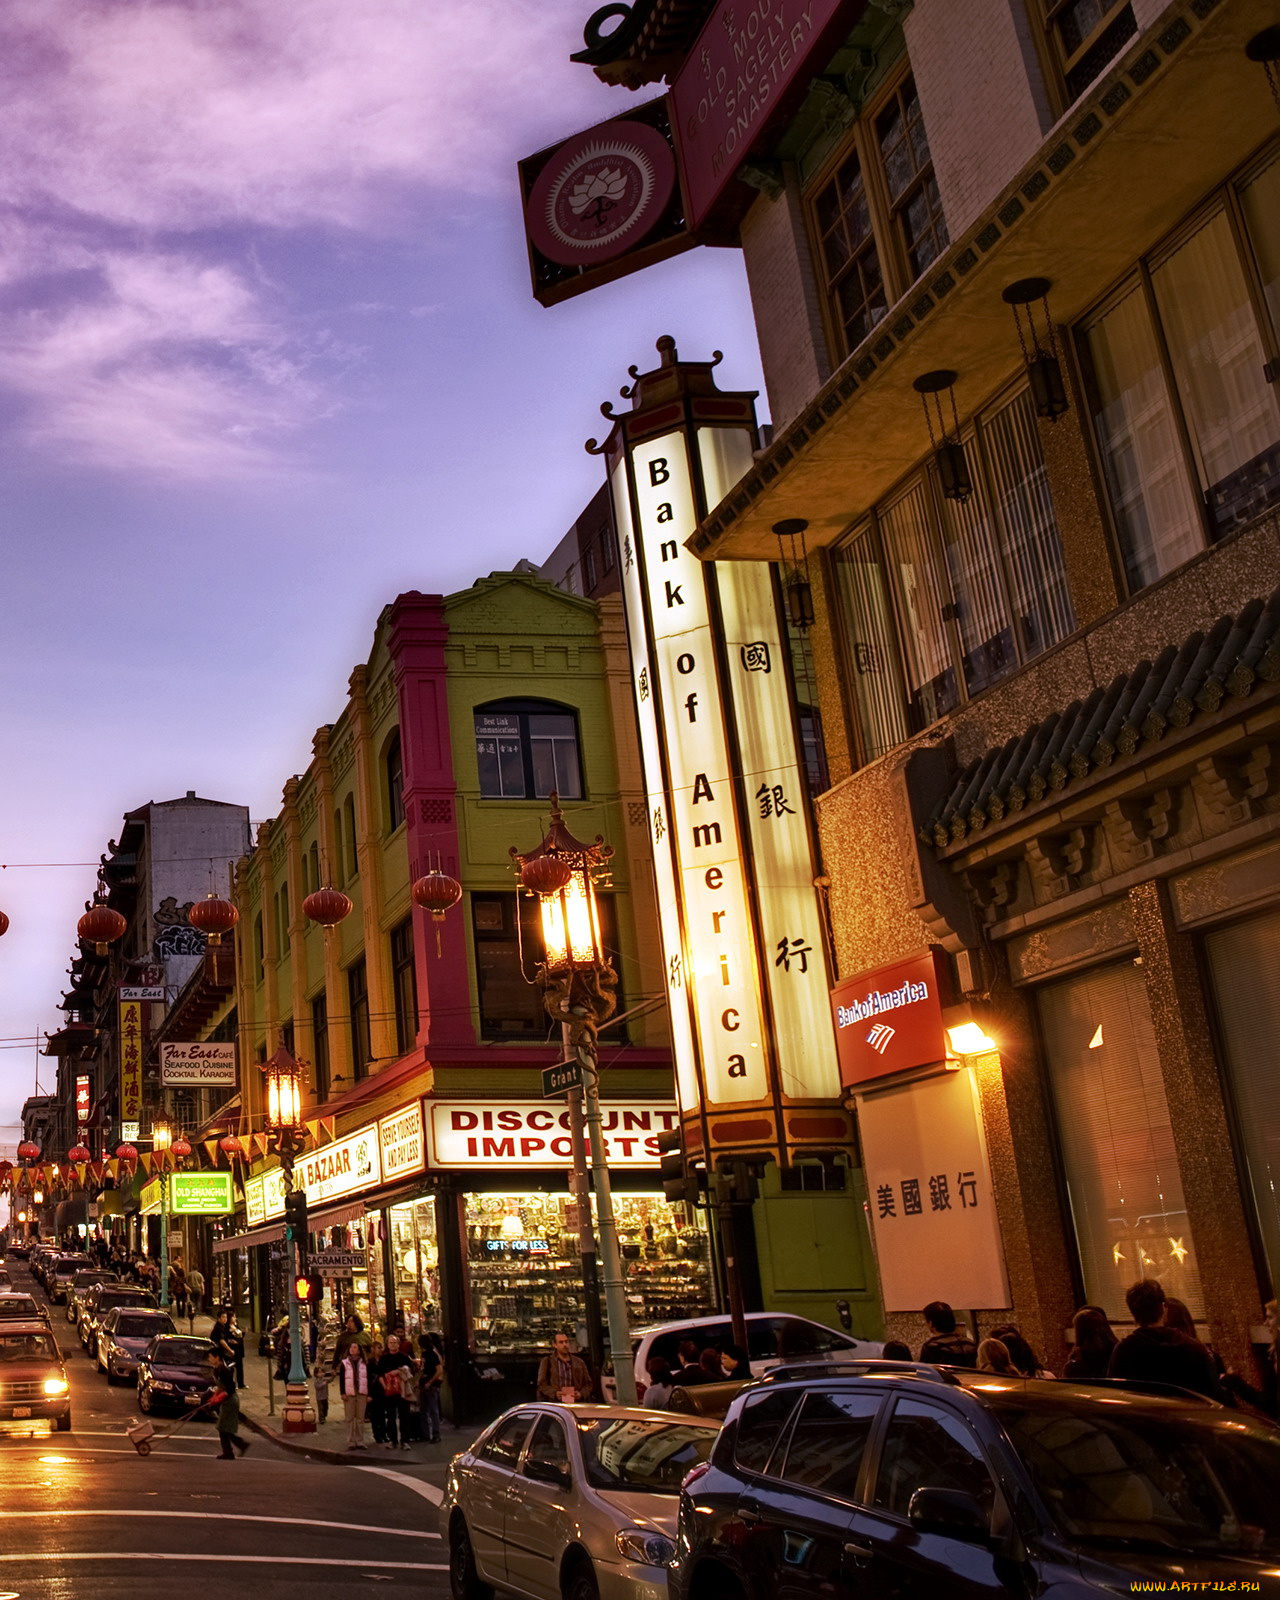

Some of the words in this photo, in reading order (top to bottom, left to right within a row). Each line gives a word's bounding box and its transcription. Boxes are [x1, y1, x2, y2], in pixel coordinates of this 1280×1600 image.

[725, 2, 784, 117] SAGELY
[712, 2, 812, 177] MONASTERY
[688, 67, 726, 141] GOLD
[483, 717, 496, 726] Best
[496, 717, 509, 726] Link
[476, 726, 518, 734] Communications
[649, 457, 685, 608] Bank
[677, 652, 699, 723] of
[692, 773, 747, 1079] America
[122, 988, 138, 998] Far
[141, 988, 162, 998] East
[163, 1044, 187, 1060] Far
[188, 1044, 220, 1060] East
[164, 1060, 200, 1069] SEAFOOD
[202, 1060, 234, 1069] CUISINE
[163, 1069, 198, 1079] COCKTAIL
[199, 1069, 234, 1079] KARAOKE
[550, 1066, 577, 1089] Grant
[450, 1110, 679, 1131] DISCOUNT
[307, 1148, 352, 1186] BAZAAR
[176, 1187, 191, 1197] OLD
[191, 1187, 227, 1197] SHANGHAI
[876, 1171, 979, 1220] 美國銀行
[486, 1240, 509, 1251] GIFTS
[511, 1240, 528, 1251] FOR
[529, 1240, 549, 1250] LESS
[307, 1255, 364, 1265] SACRAMENTO
